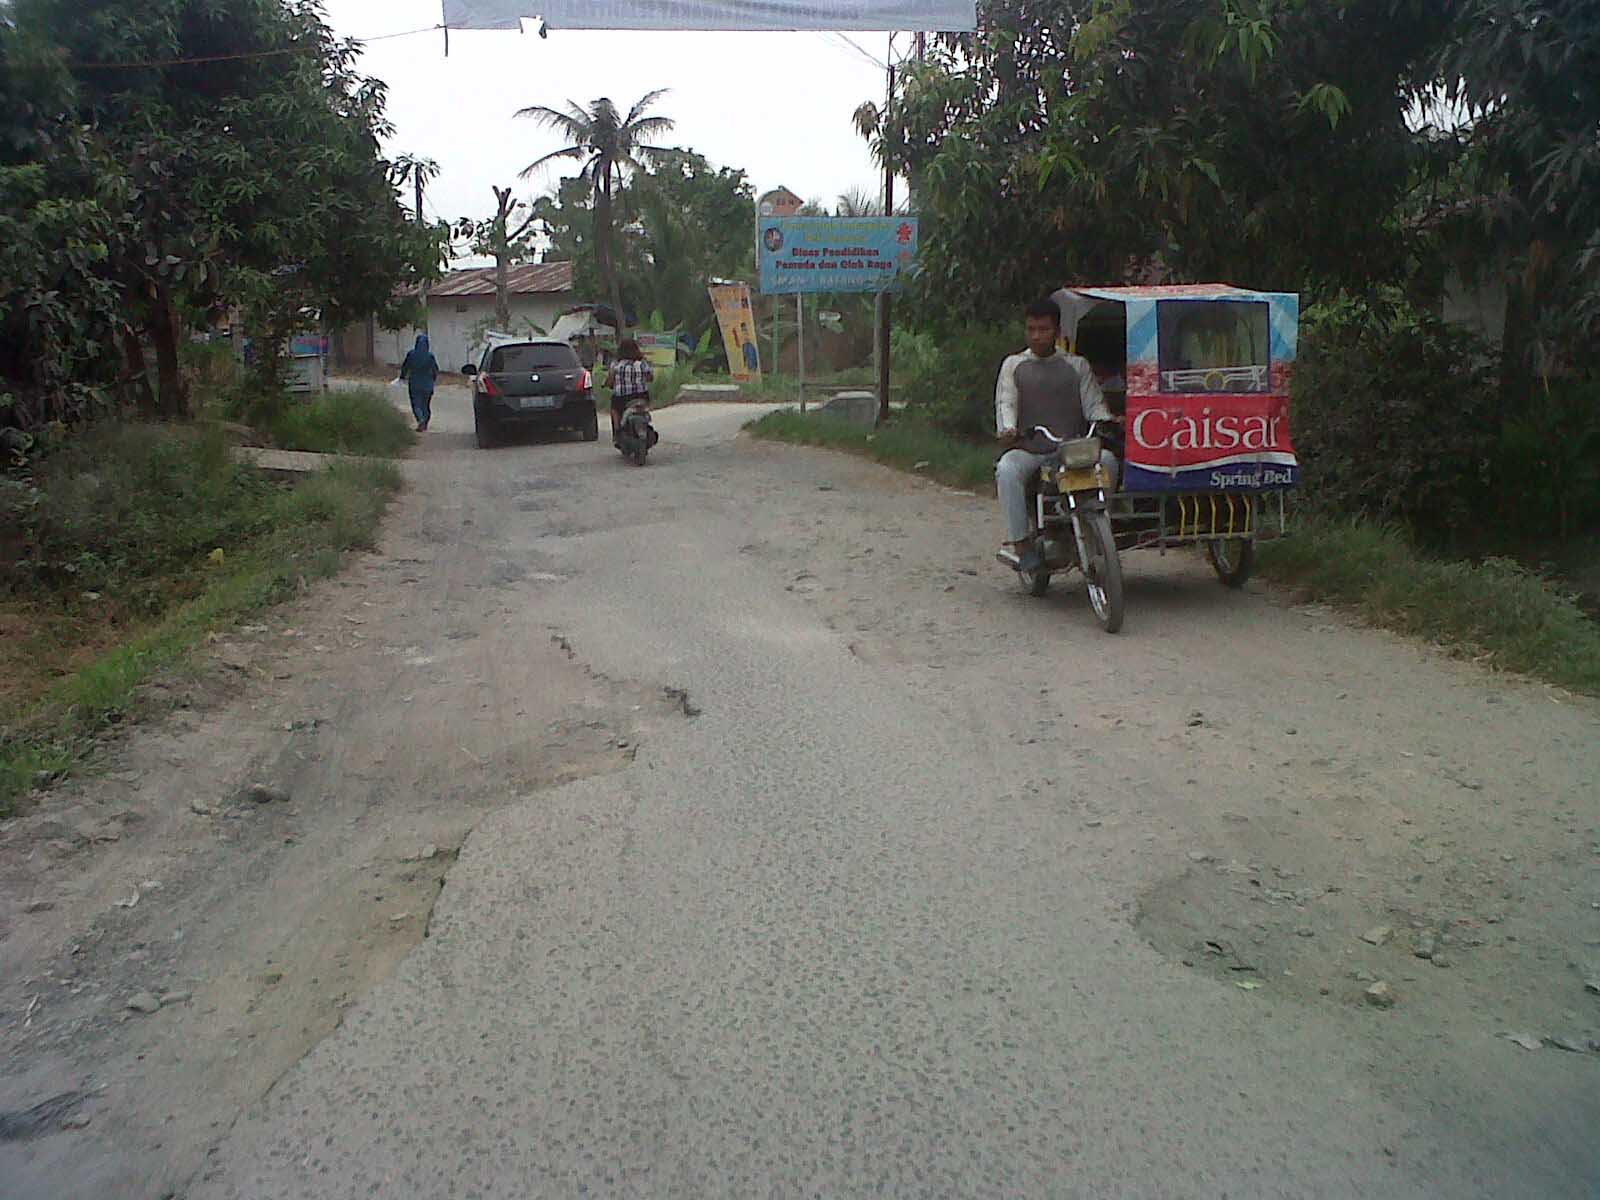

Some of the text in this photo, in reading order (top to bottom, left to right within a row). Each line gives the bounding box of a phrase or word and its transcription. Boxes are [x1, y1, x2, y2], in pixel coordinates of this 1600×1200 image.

[823, 247, 880, 257] Pendidikan
[775, 259, 816, 270] Pemuda
[818, 260, 837, 270] dan
[1132, 407, 1281, 450] Caisar
[1209, 468, 1293, 488] Spring Bed
